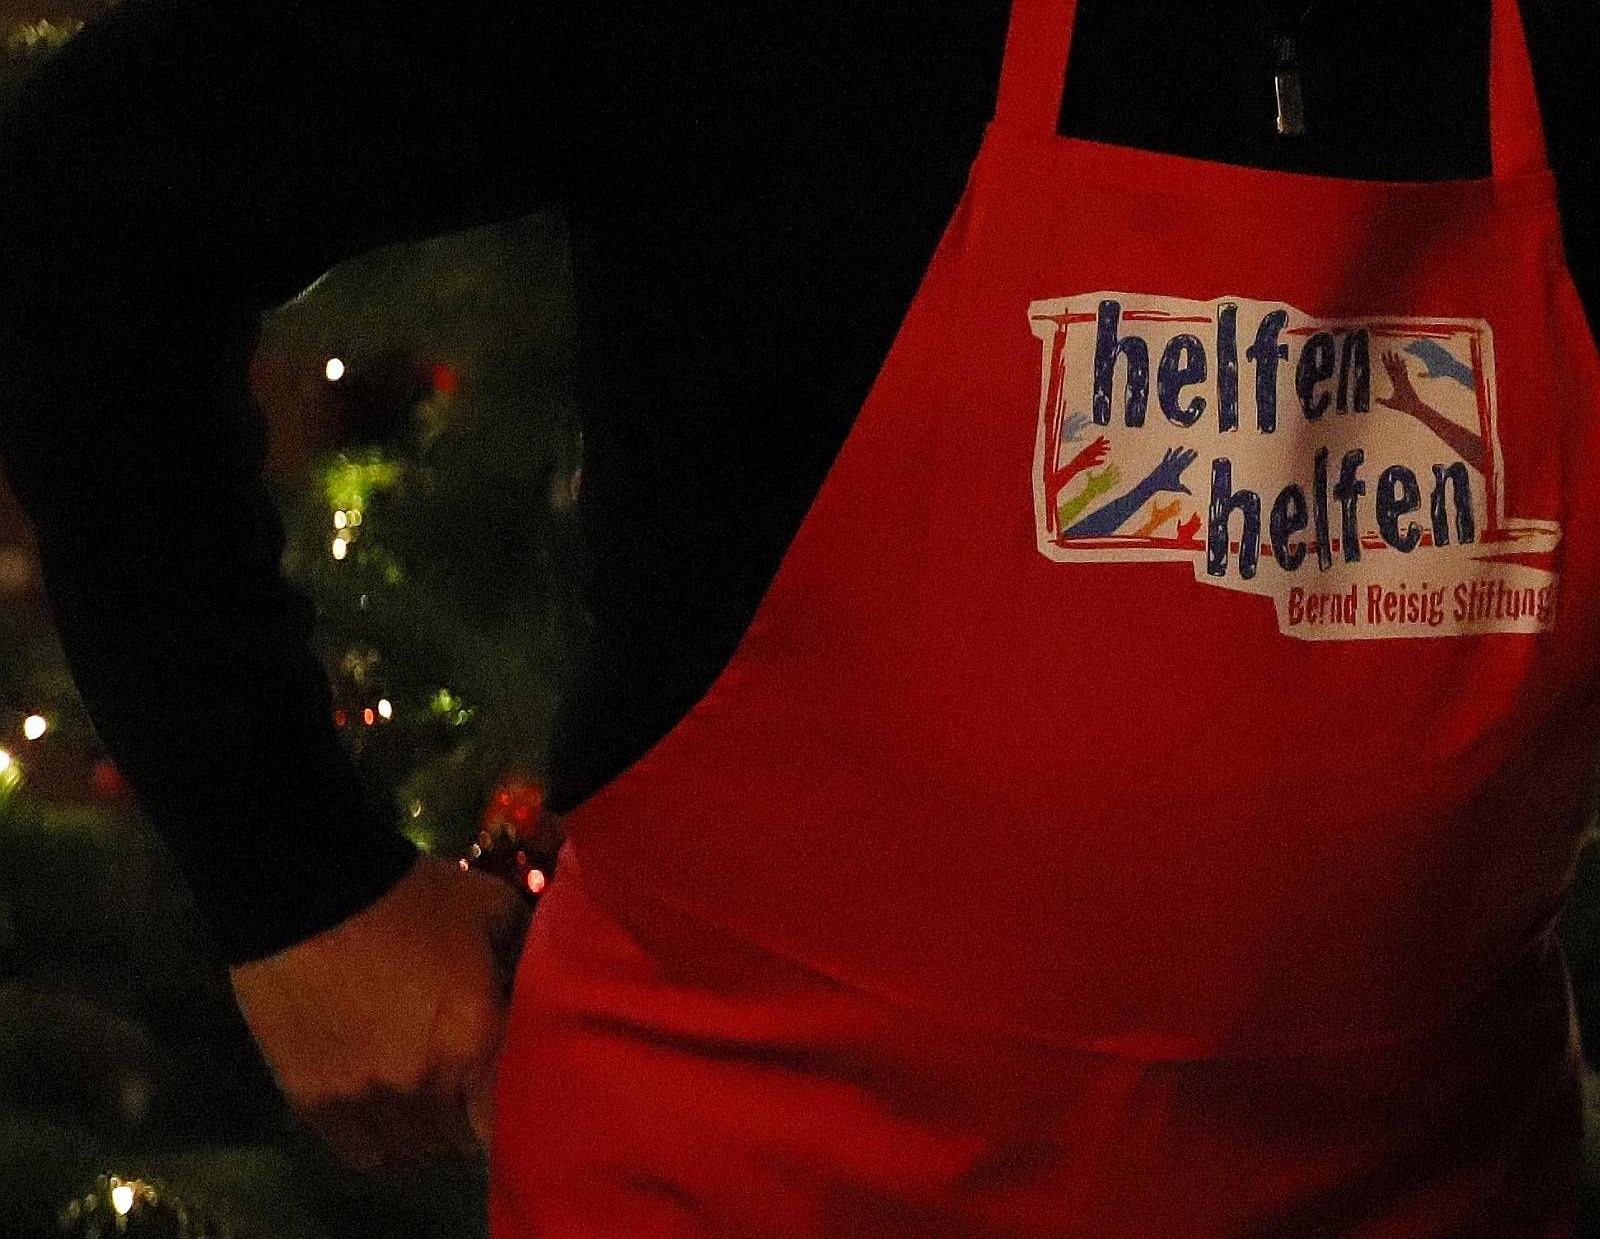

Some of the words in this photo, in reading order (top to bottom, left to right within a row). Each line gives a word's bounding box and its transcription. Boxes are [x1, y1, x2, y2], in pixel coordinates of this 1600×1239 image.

[1092, 300, 1371, 433] helfen
[1206, 447, 1475, 579] helfen
[1288, 585, 1359, 626] Bernd
[1367, 583, 1444, 626] Reisig
[1453, 579, 1555, 625] Stiftung
